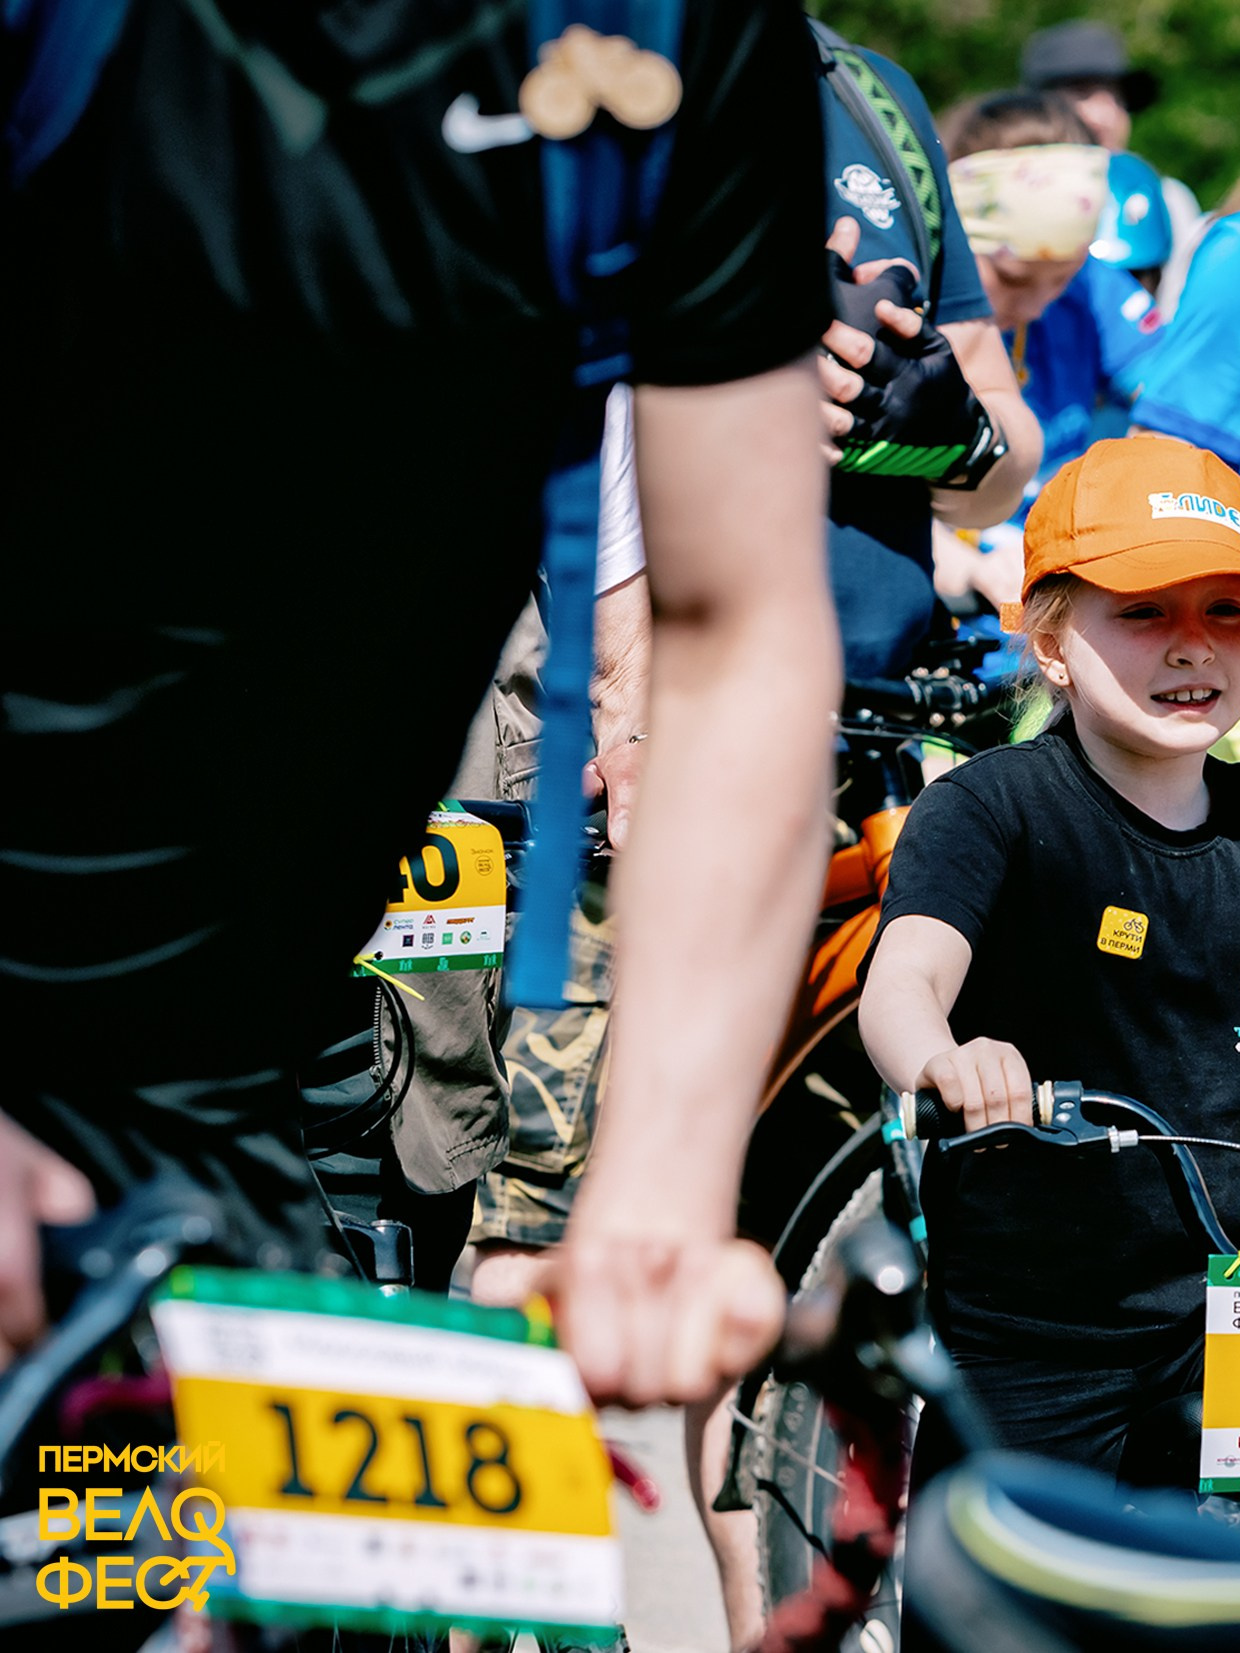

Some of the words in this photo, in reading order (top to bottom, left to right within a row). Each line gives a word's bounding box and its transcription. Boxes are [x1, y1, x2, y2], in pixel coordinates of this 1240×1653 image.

[1113, 929, 1143, 943] КРУТИ
[1100, 937, 1107, 945] В
[1108, 938, 1141, 954] ПЕРМИ
[267, 1401, 523, 1515] 1218
